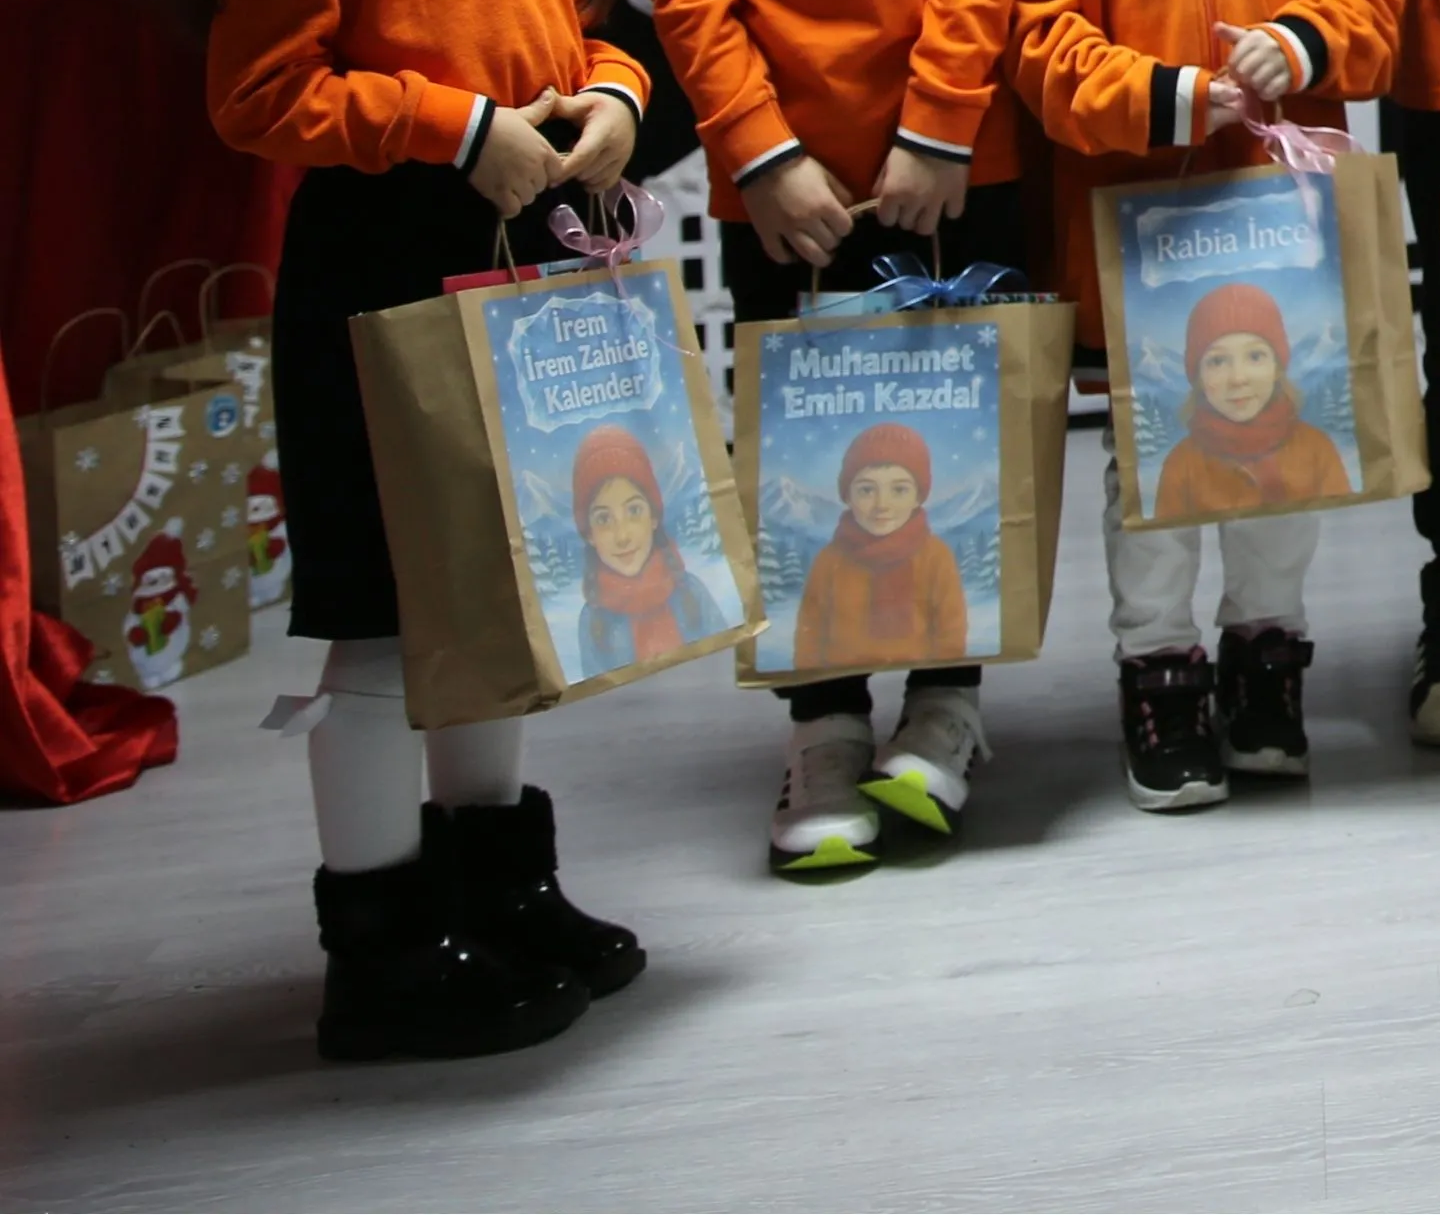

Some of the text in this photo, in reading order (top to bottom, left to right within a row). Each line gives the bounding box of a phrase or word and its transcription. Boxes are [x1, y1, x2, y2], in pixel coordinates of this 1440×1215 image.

[1156, 229, 1239, 262] Rabia
[552, 310, 608, 343] İrem
[524, 334, 649, 382] İrem Zahide
[789, 344, 975, 380] Muhammet
[543, 371, 646, 414] Kalender
[785, 377, 981, 419] Emin Kazdal
